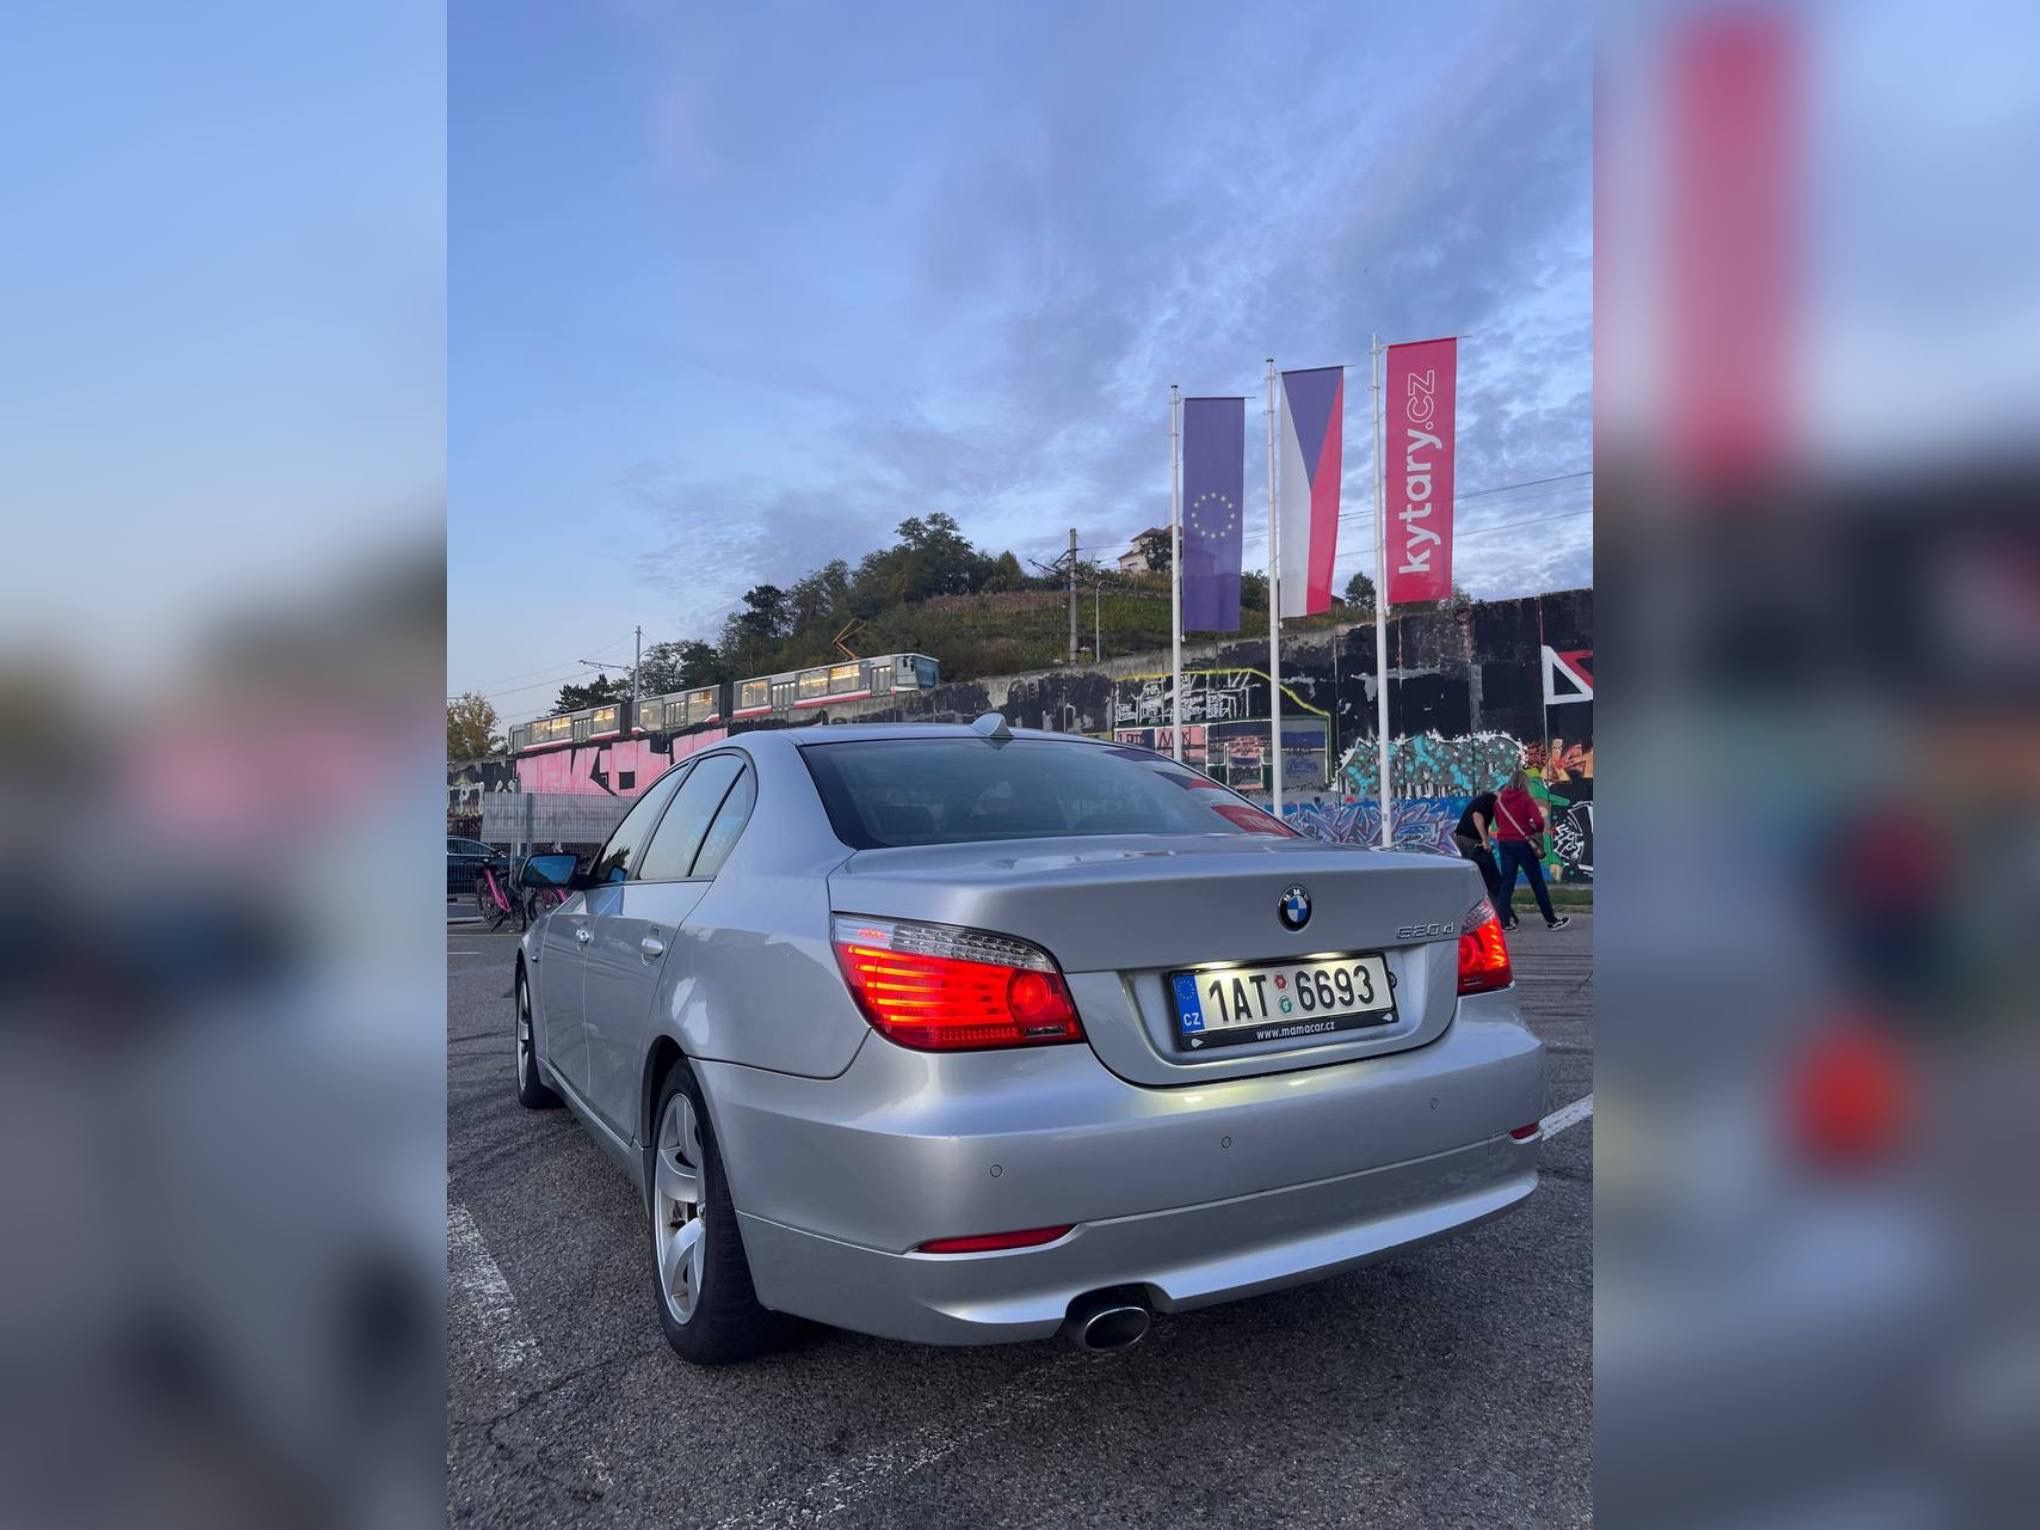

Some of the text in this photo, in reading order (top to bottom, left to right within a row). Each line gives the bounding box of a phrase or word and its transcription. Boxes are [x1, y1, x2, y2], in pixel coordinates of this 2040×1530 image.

[1398, 369, 1442, 575] kytary.cz
[1209, 965, 1374, 1022] 1AT 6693
[1183, 1012, 1201, 1027] CZ
[1256, 1022, 1335, 1040] www.mamacar.cz
